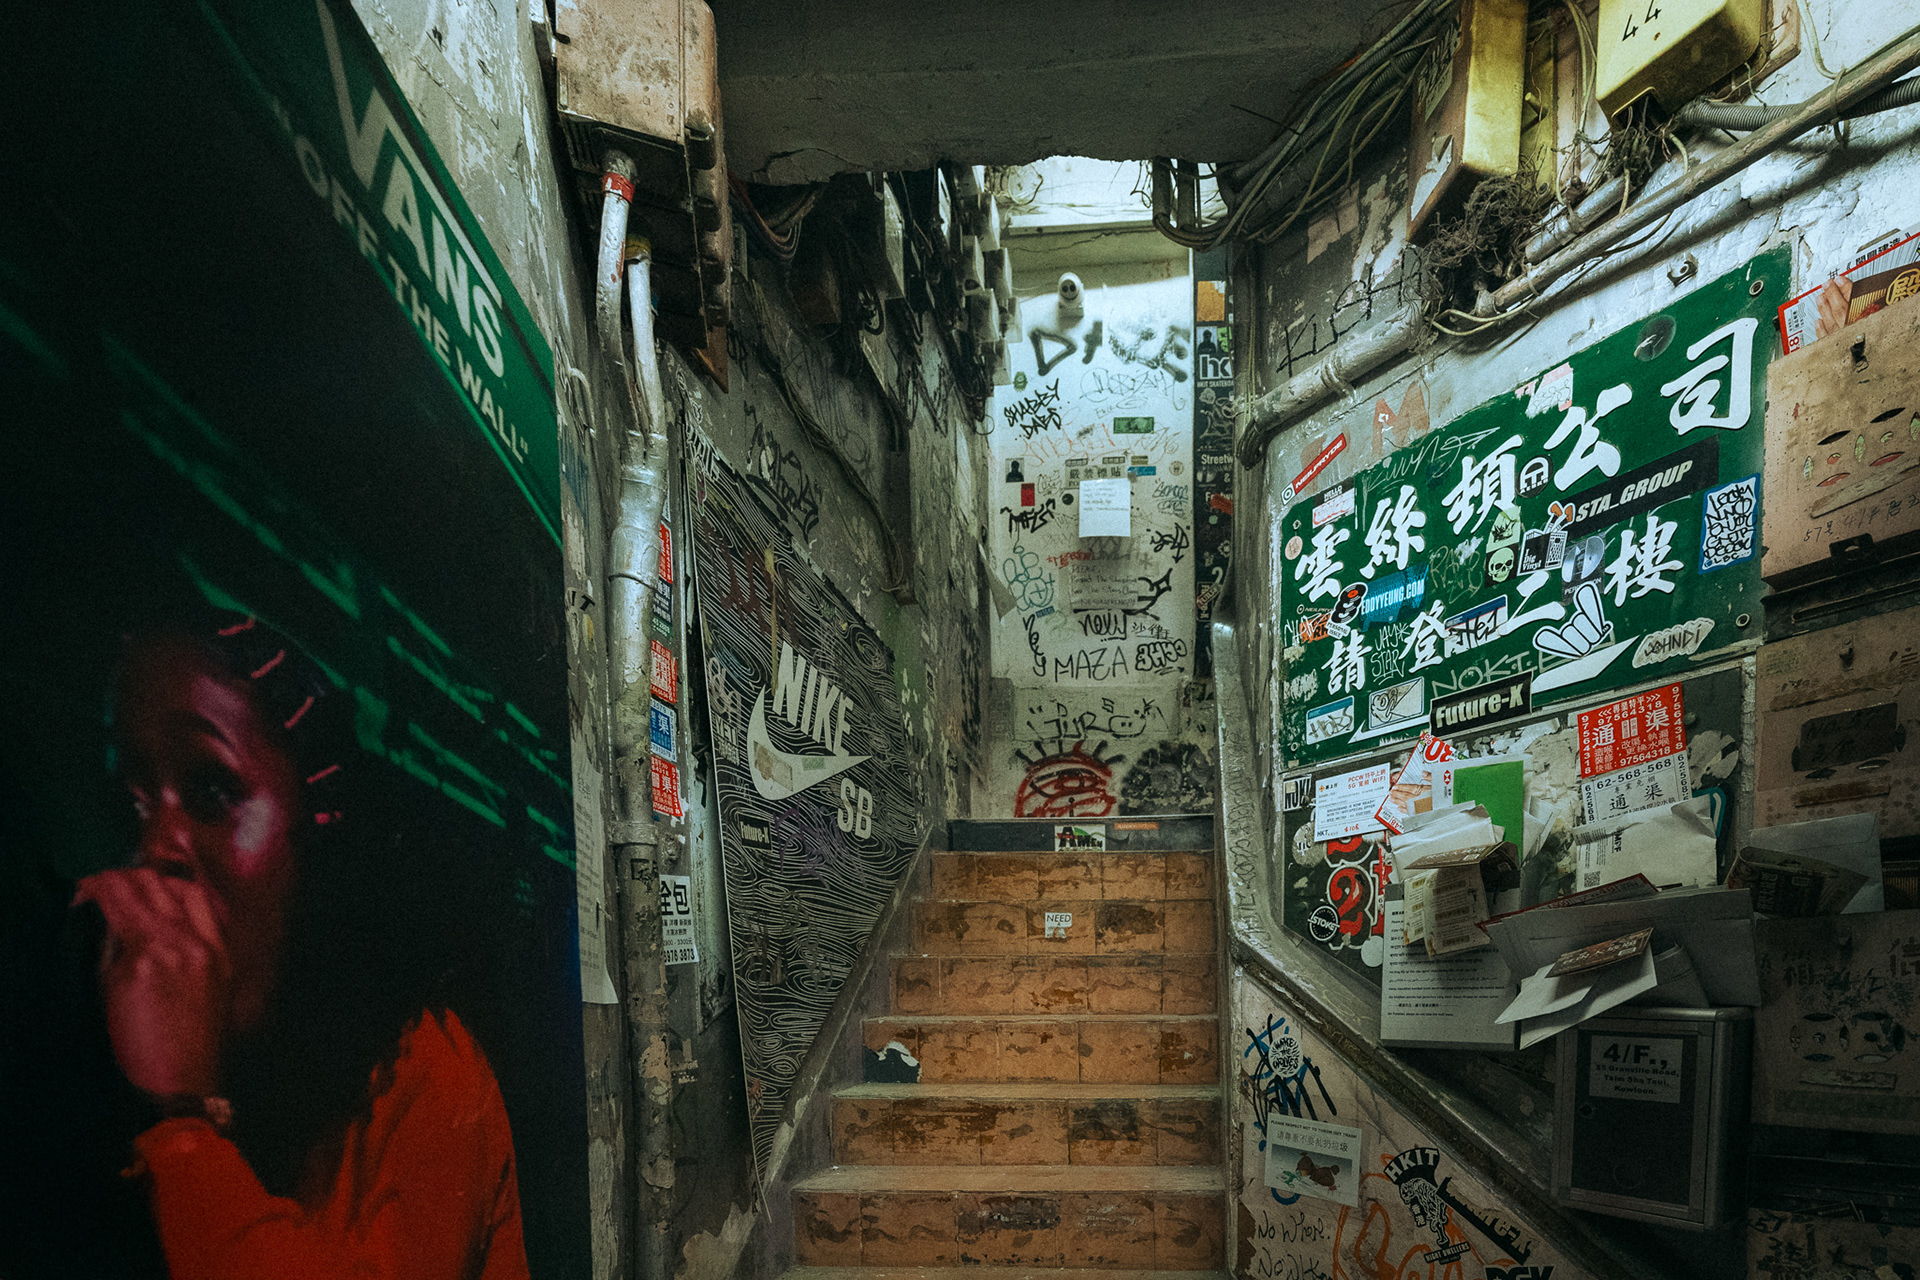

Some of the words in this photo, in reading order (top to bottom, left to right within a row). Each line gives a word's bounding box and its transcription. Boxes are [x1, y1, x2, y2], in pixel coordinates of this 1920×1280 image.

[316, 0, 504, 379] VANS
[387, 254, 450, 367] THE
[1575, 460, 1694, 523] STA_GROUP
[771, 641, 855, 753] NIKE
[1435, 683, 1524, 729] Future-X
[1597, 758, 1672, 790] 62-568-568
[837, 777, 873, 840] SB
[1047, 914, 1072, 923] NEED
[1312, 916, 1336, 931] STOKE
[1608, 1066, 1650, 1074] Granville
[1652, 1068, 1680, 1078] Road,
[1627, 1076, 1644, 1084] Sha
[1385, 1149, 1439, 1183] HKIT
